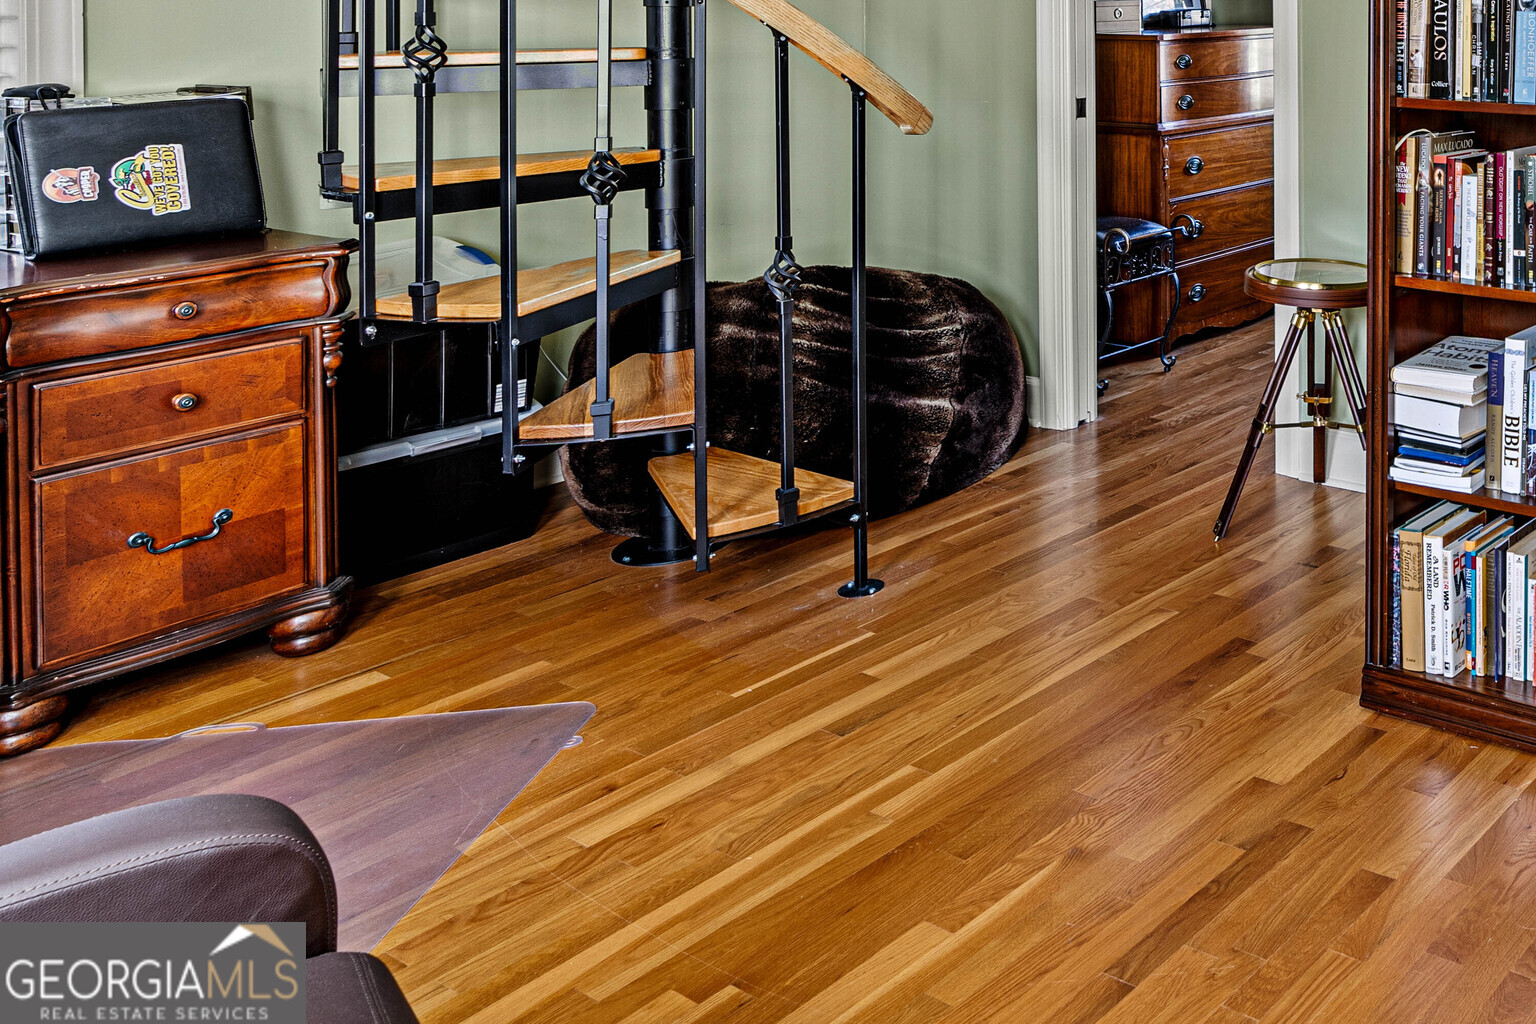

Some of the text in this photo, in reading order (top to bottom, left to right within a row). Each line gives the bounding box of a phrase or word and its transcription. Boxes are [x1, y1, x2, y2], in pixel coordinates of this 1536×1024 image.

[1527, 13, 1536, 78] BONHOEFFER
[1431, 80, 1449, 88] Collier
[149, 147, 167, 214] WE'VE GOT YOU
[161, 146, 182, 210] COVERED!
[1491, 359, 1499, 398] HEAVEN
[1503, 415, 1521, 468] BIBLE
